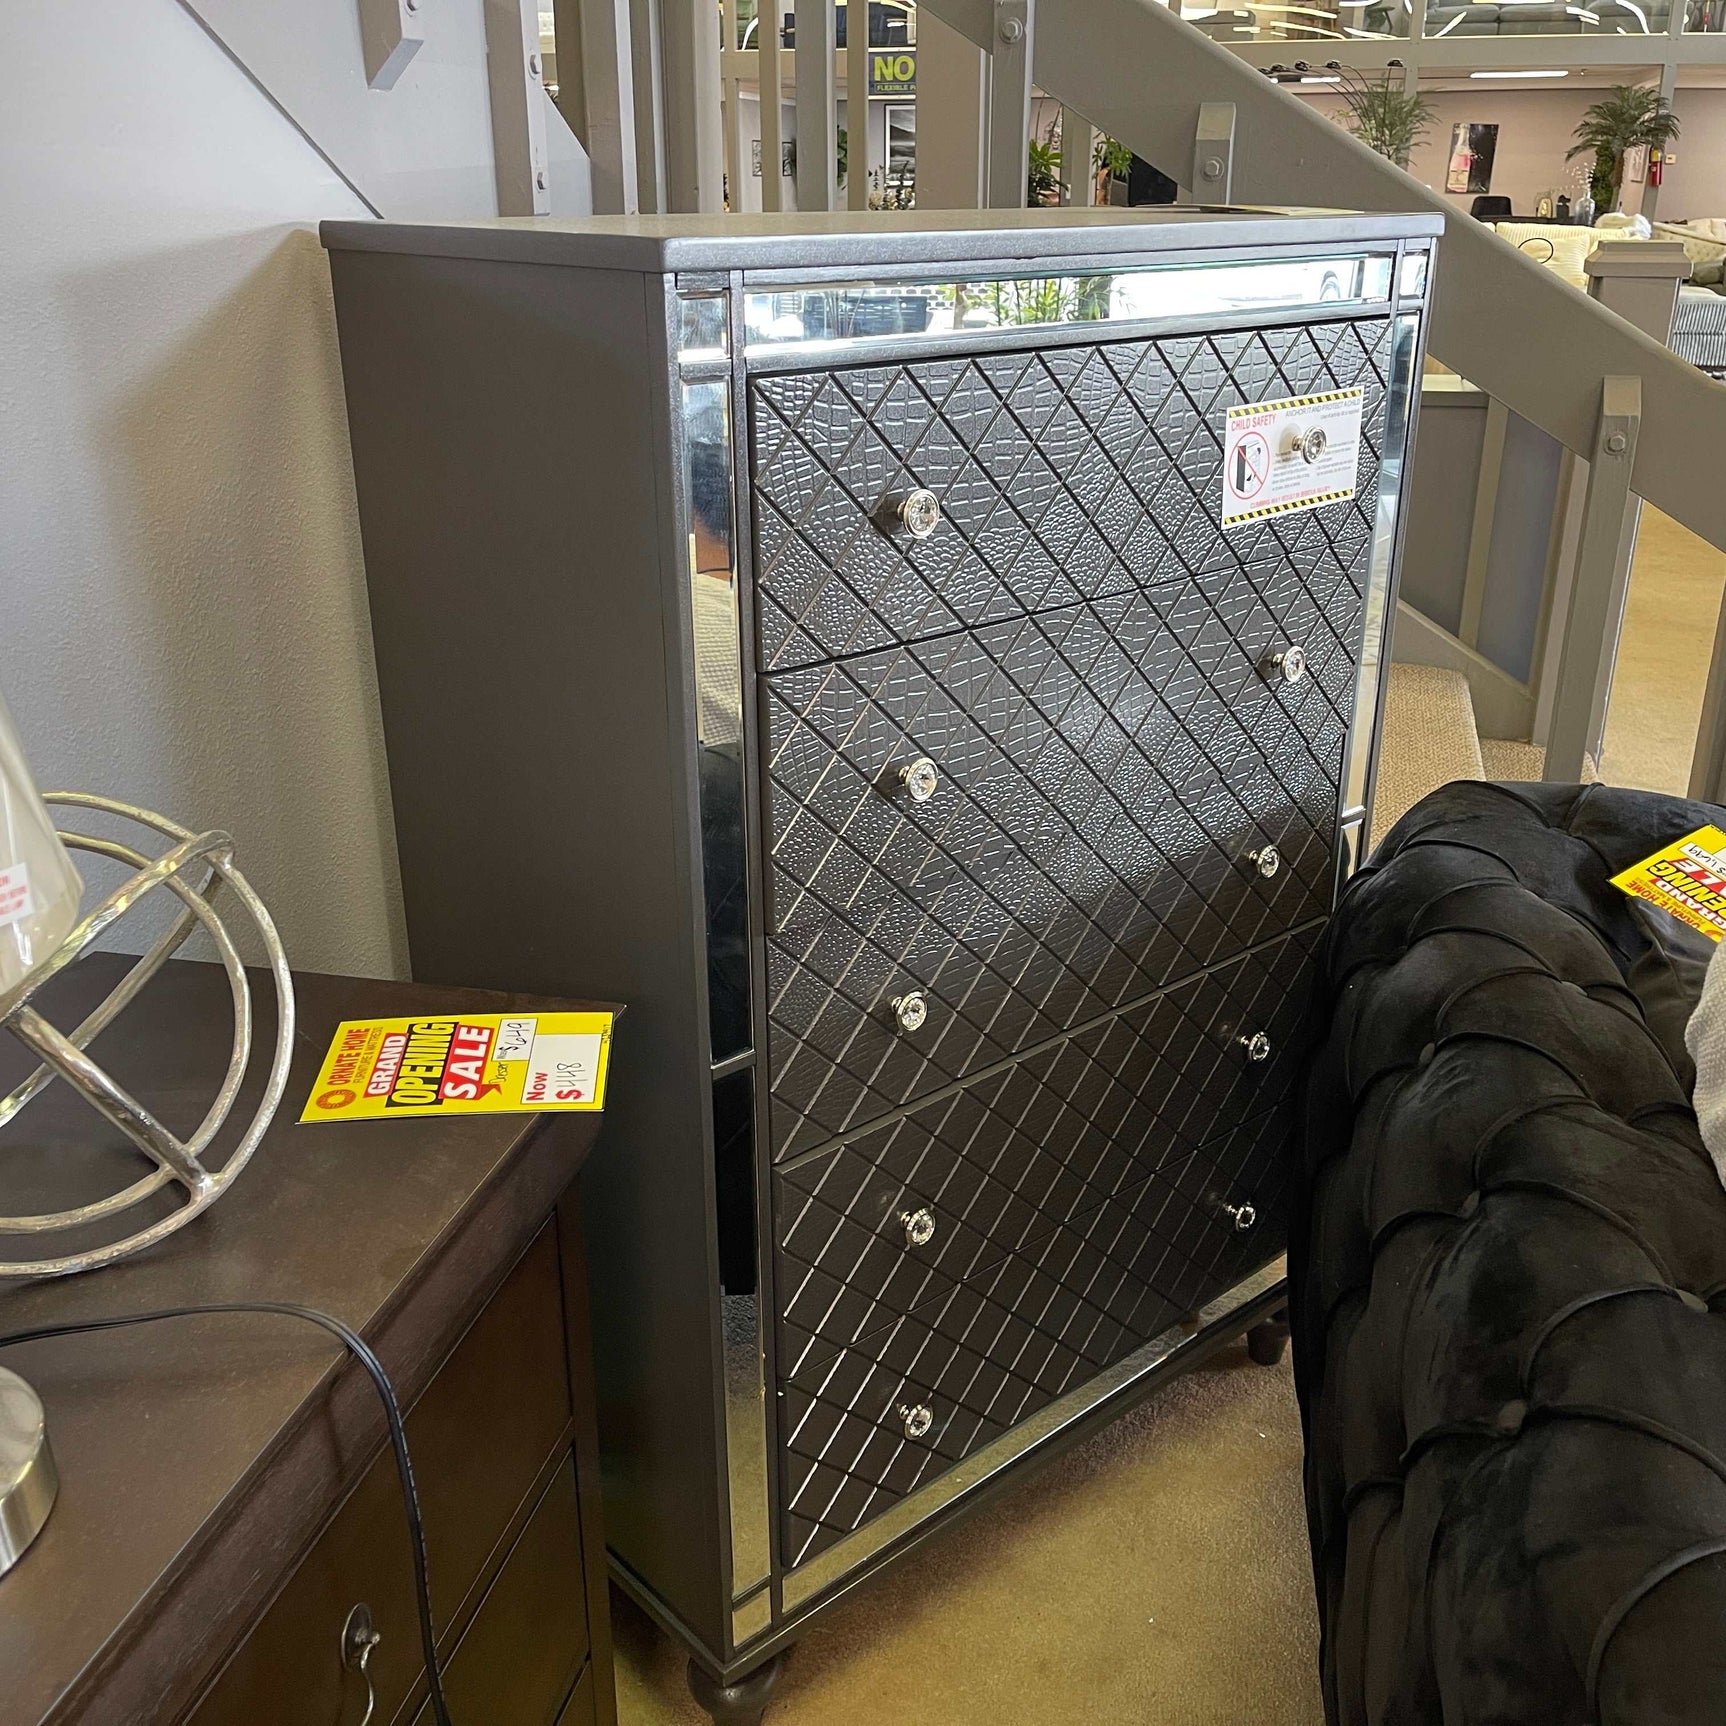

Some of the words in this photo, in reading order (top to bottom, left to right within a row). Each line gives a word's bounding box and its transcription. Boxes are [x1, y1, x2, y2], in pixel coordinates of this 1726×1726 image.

[874, 55, 915, 81] NO
[1231, 415, 1251, 431] CHILD
[1251, 413, 1277, 428] SAFETY
[1625, 880, 1660, 902] HOME
[341, 1028, 369, 1052] HOME
[498, 1022, 530, 1051] $649
[327, 1052, 361, 1085] ORNATE
[367, 1035, 407, 1095] GRAND
[391, 1023, 455, 1104] OPENING
[443, 1026, 491, 1099] SALE
[526, 1072, 549, 1101] Now
[555, 1063, 589, 1100] $448
